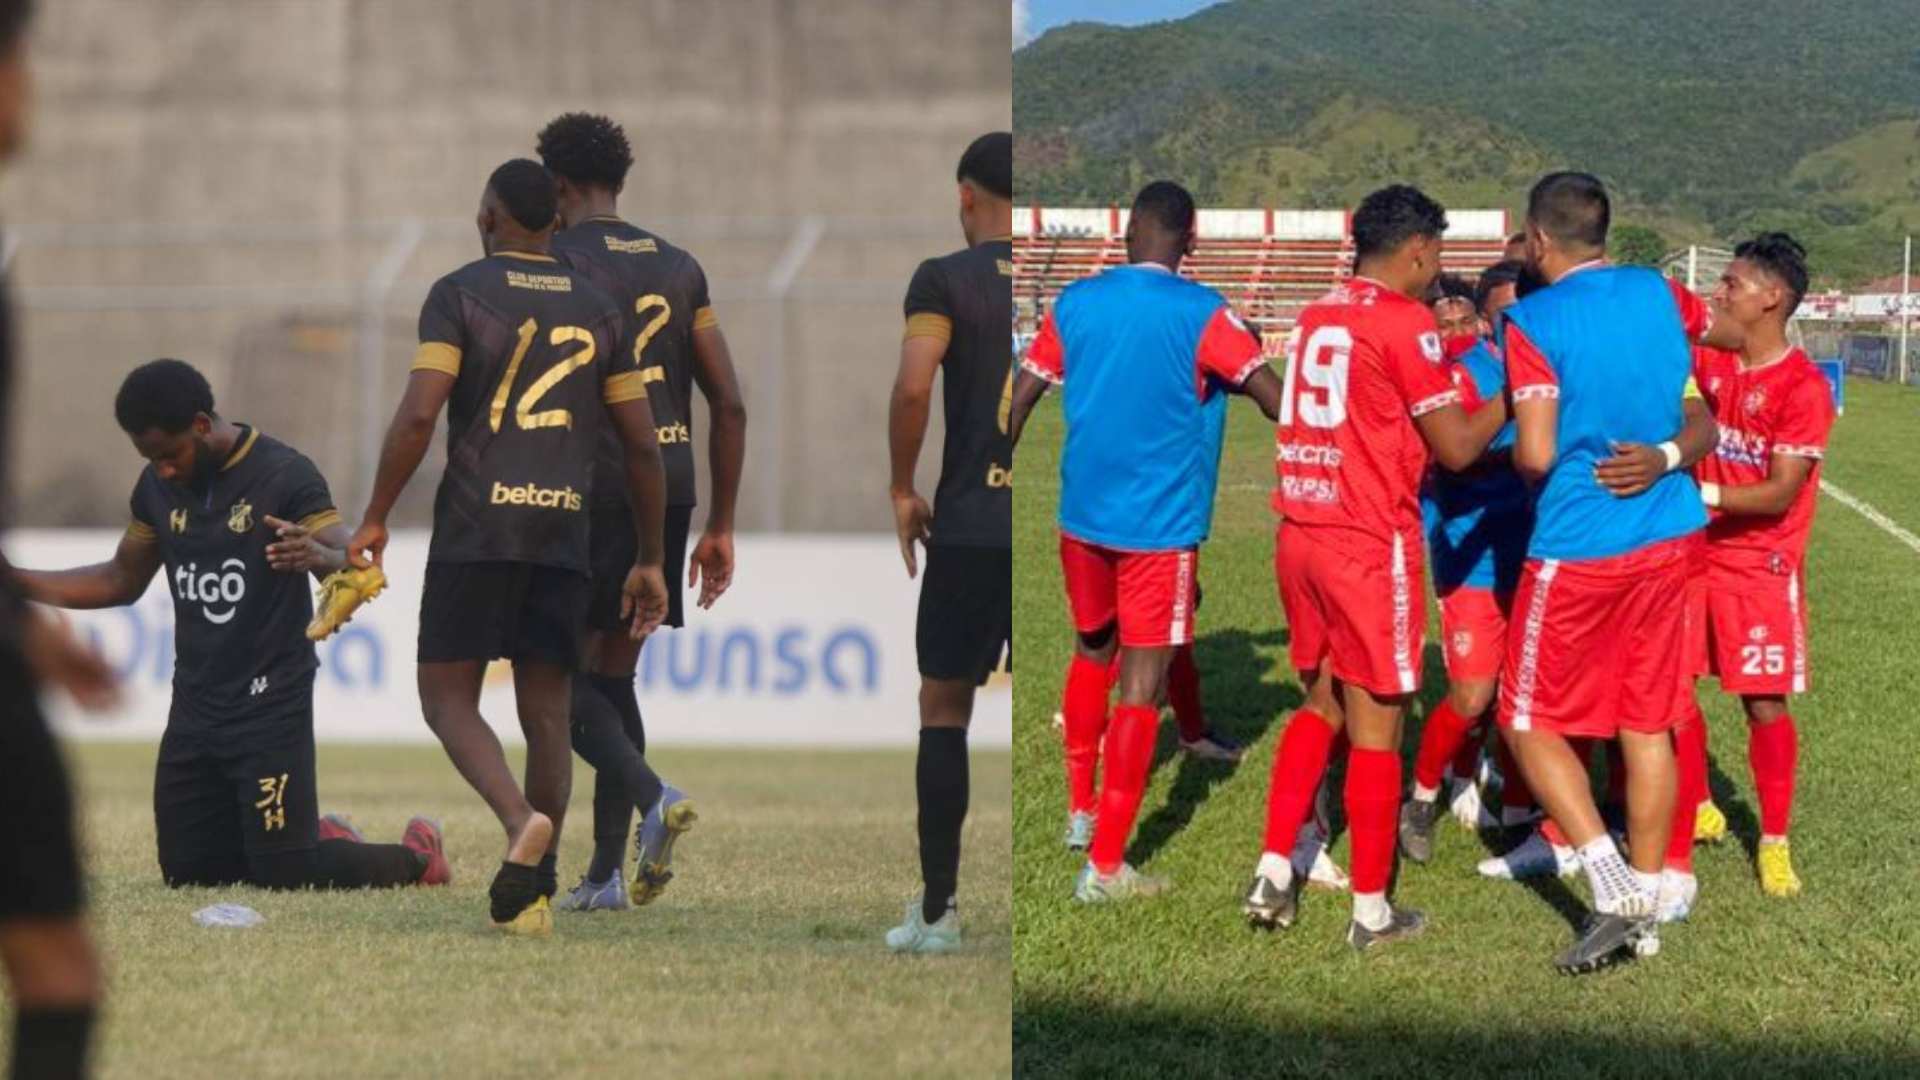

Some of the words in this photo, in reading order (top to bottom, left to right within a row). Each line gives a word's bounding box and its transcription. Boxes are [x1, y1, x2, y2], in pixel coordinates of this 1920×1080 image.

[490, 318, 596, 432] 12
[1278, 325, 1353, 428] 19
[491, 482, 582, 511] betcris
[1741, 645, 1785, 675] 25
[256, 773, 289, 808] 31
